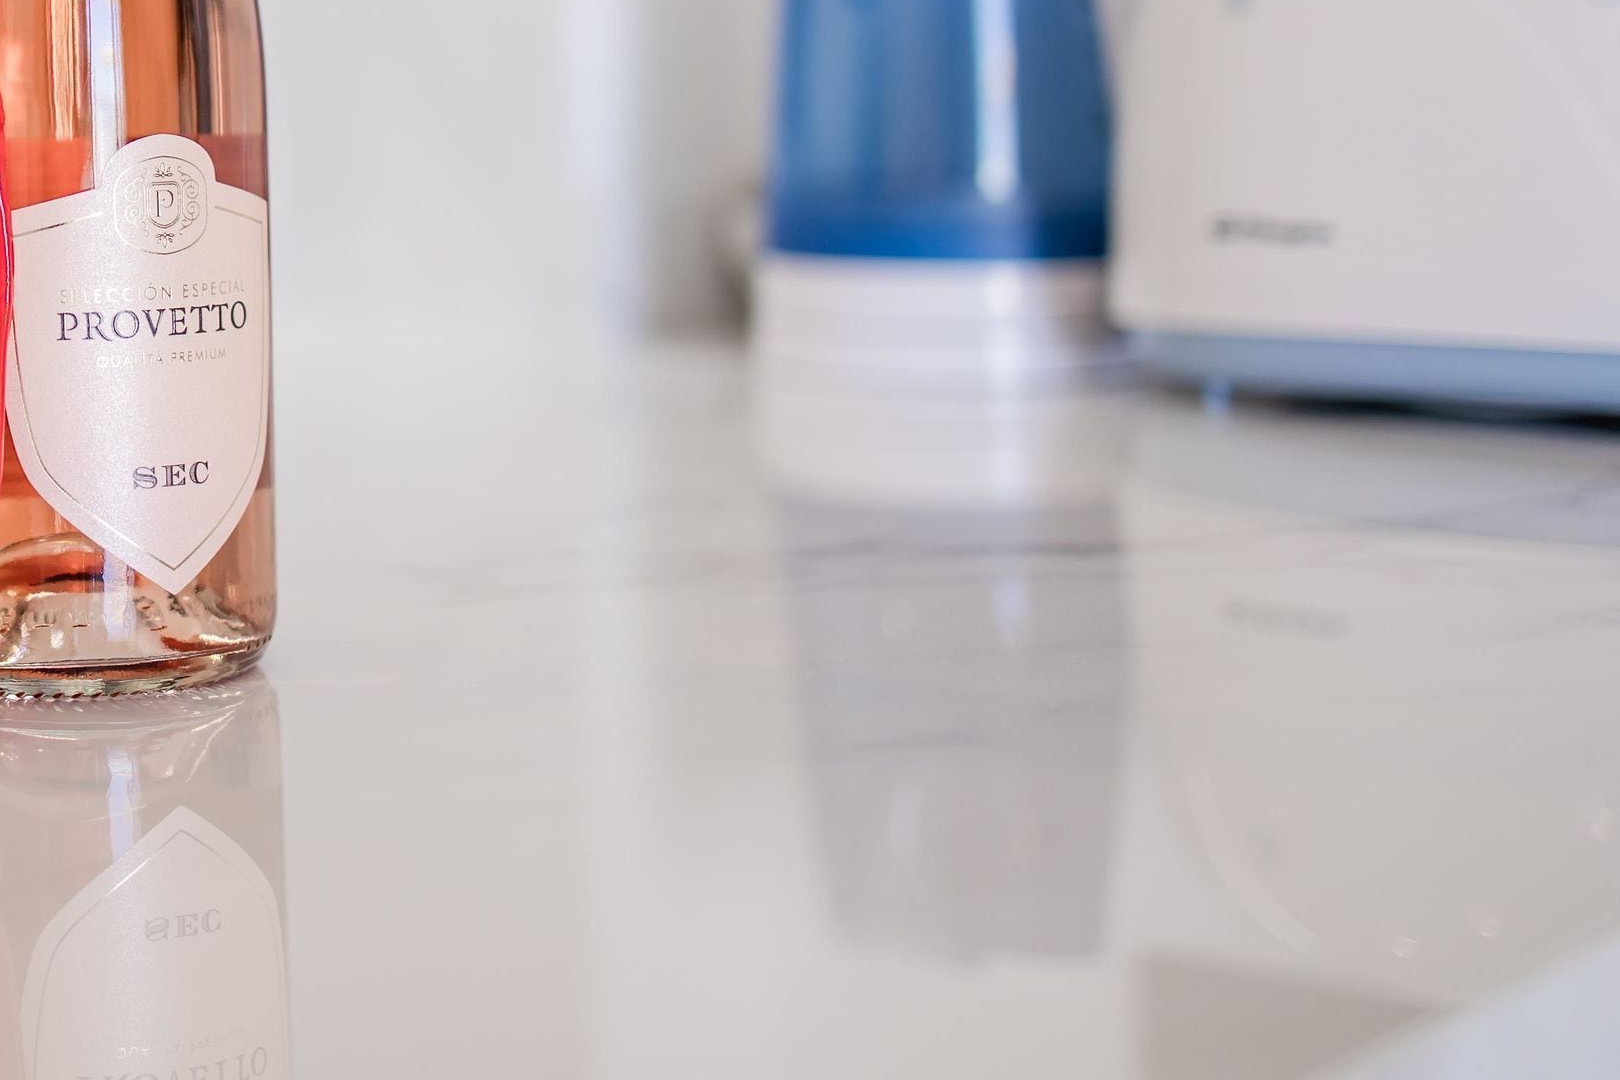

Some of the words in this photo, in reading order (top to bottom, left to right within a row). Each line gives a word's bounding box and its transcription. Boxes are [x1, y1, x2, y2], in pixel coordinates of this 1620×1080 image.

[155, 189, 174, 218] P
[182, 278, 245, 298] ESPECIAL
[56, 300, 247, 341] PROVETTO
[96, 349, 164, 369] QUAITÀ
[171, 347, 227, 364] PREMIUM
[132, 461, 209, 490] SEC
